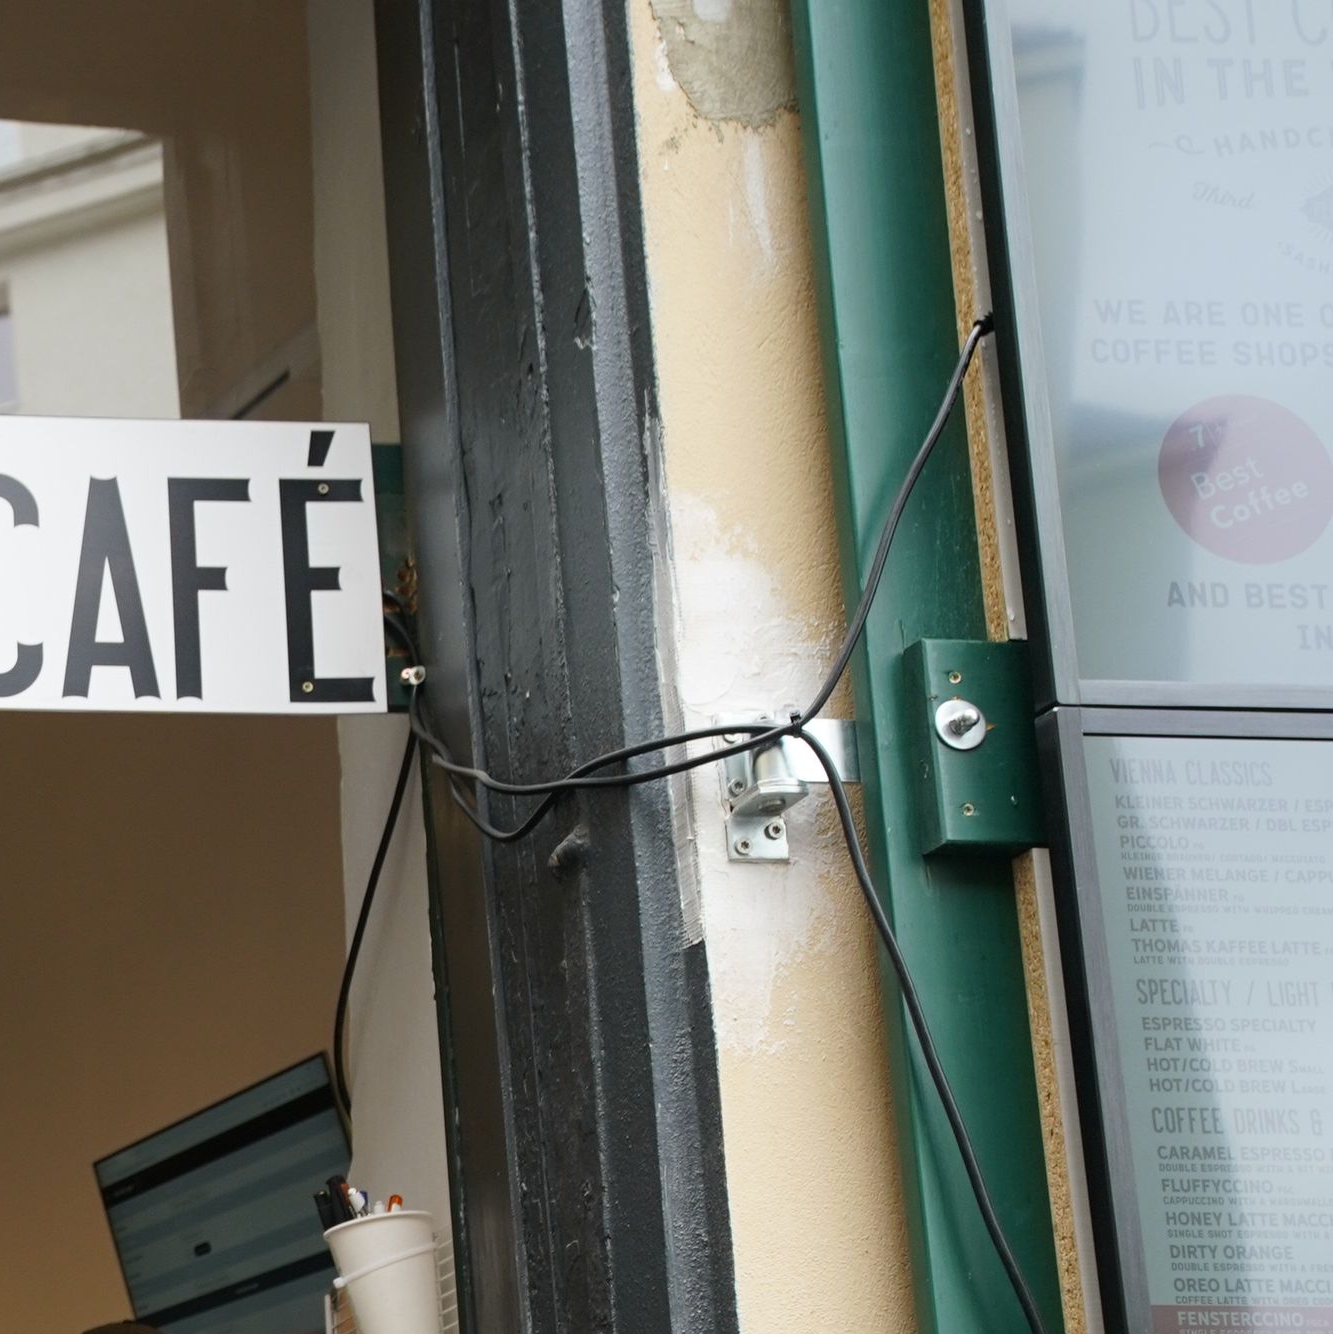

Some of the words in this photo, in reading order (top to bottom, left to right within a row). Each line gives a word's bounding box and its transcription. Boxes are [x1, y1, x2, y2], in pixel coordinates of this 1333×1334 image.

[1132, 56, 1186, 111] IN
[1206, 57, 1310, 101] THE
[1212, 127, 1333, 158] HANDC
[1093, 298, 1146, 326] WE
[1162, 300, 1226, 327] ARE
[1241, 301, 1304, 329] ONE
[1090, 338, 1218, 366] COFFEE
[1190, 455, 1265, 501] Best
[1210, 480, 1310, 529] Coffee
[1166, 580, 1230, 609] AND
[1245, 581, 1329, 611] BEST
[1108, 758, 1177, 785] VIENNA
[1185, 759, 1274, 787] CLASSICS
[1114, 795, 1183, 811] KLEINER
[1188, 796, 1288, 812] SCHWARZER
[1148, 816, 1249, 832] SCHWARZER
[1266, 818, 1298, 832] DBL
[1119, 835, 1189, 850] PICCOLO
[1123, 867, 1186, 882] WIENER
[1191, 868, 1270, 883] MELANGE
[1130, 918, 1180, 933] LATTE
[1131, 938, 1202, 953] THOMAS
[1206, 939, 1267, 954] KAFFEE
[1271, 940, 1321, 955] LATTE
[1136, 978, 1231, 1006] SPECIALTY
[1267, 981, 1320, 1007] LIGHT
[1141, 1016, 1226, 1032] ESPRESSO
[1230, 1018, 1317, 1033] SPECIALTY
[1144, 1037, 1183, 1052] FLAT
[1186, 1038, 1241, 1053] WHITE
[1147, 1057, 1233, 1073] HOT/COLD
[1236, 1059, 1283, 1074] BREW
[1149, 1078, 1235, 1093] HOT/COLD
[1239, 1079, 1286, 1094] BREW
[1151, 1106, 1225, 1134] COFFEE
[1234, 1107, 1301, 1135] DRINKS
[1157, 1145, 1234, 1161] CARAMEL
[1240, 1146, 1326, 1162] ESPRESSO
[1161, 1178, 1274, 1194] FLUFFYCCINO
[1165, 1211, 1223, 1226] HONEY
[1228, 1212, 1278, 1227] LATTE
[1283, 1213, 1333, 1228] MACC
[1169, 1244, 1218, 1260] DIRTY
[1223, 1245, 1294, 1261] ORANGE
[1174, 1278, 1220, 1293] OREO
[1224, 1278, 1275, 1293] LATTE
[1176, 1311, 1304, 1328] FENSTERCCINO
